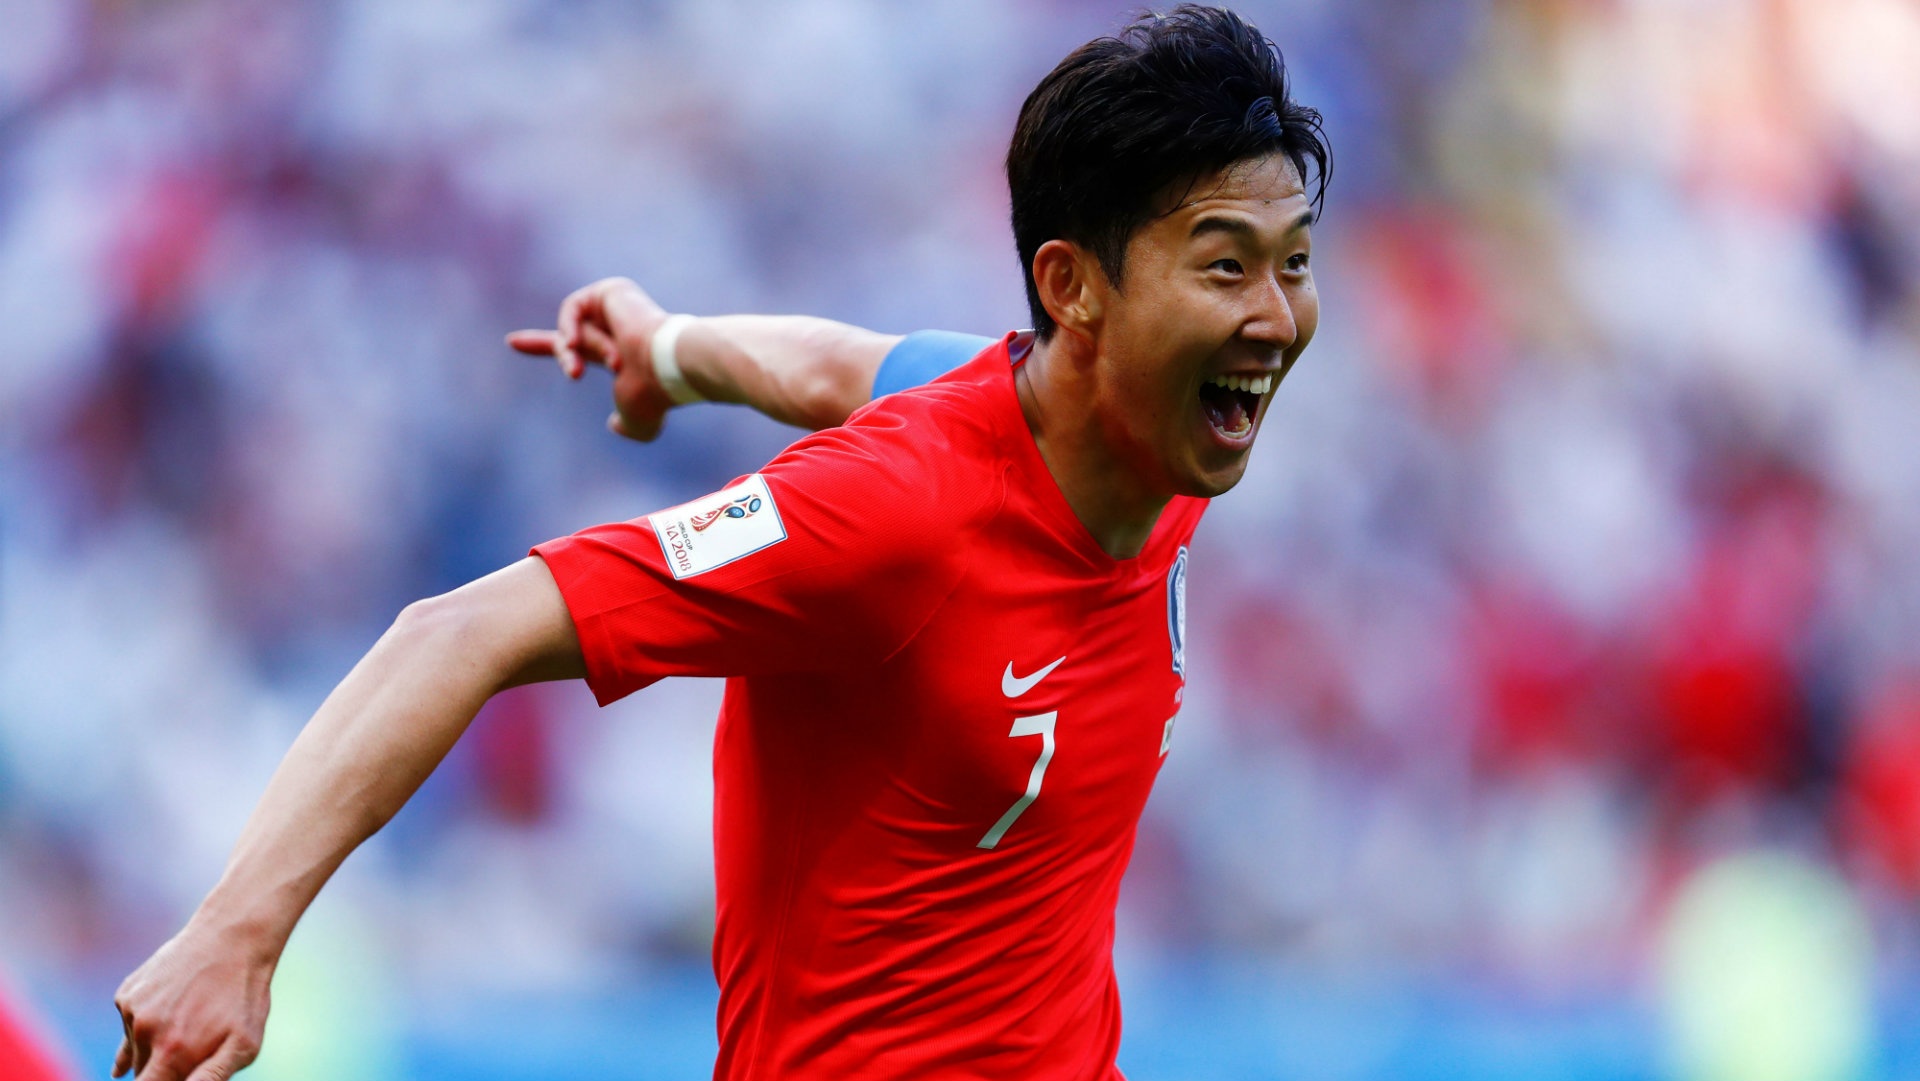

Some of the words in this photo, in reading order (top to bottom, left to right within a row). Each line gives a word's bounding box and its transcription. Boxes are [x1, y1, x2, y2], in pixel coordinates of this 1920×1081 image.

[672, 540, 692, 571] 2018
[684, 538, 693, 551] CUP
[976, 710, 1058, 850] 7
